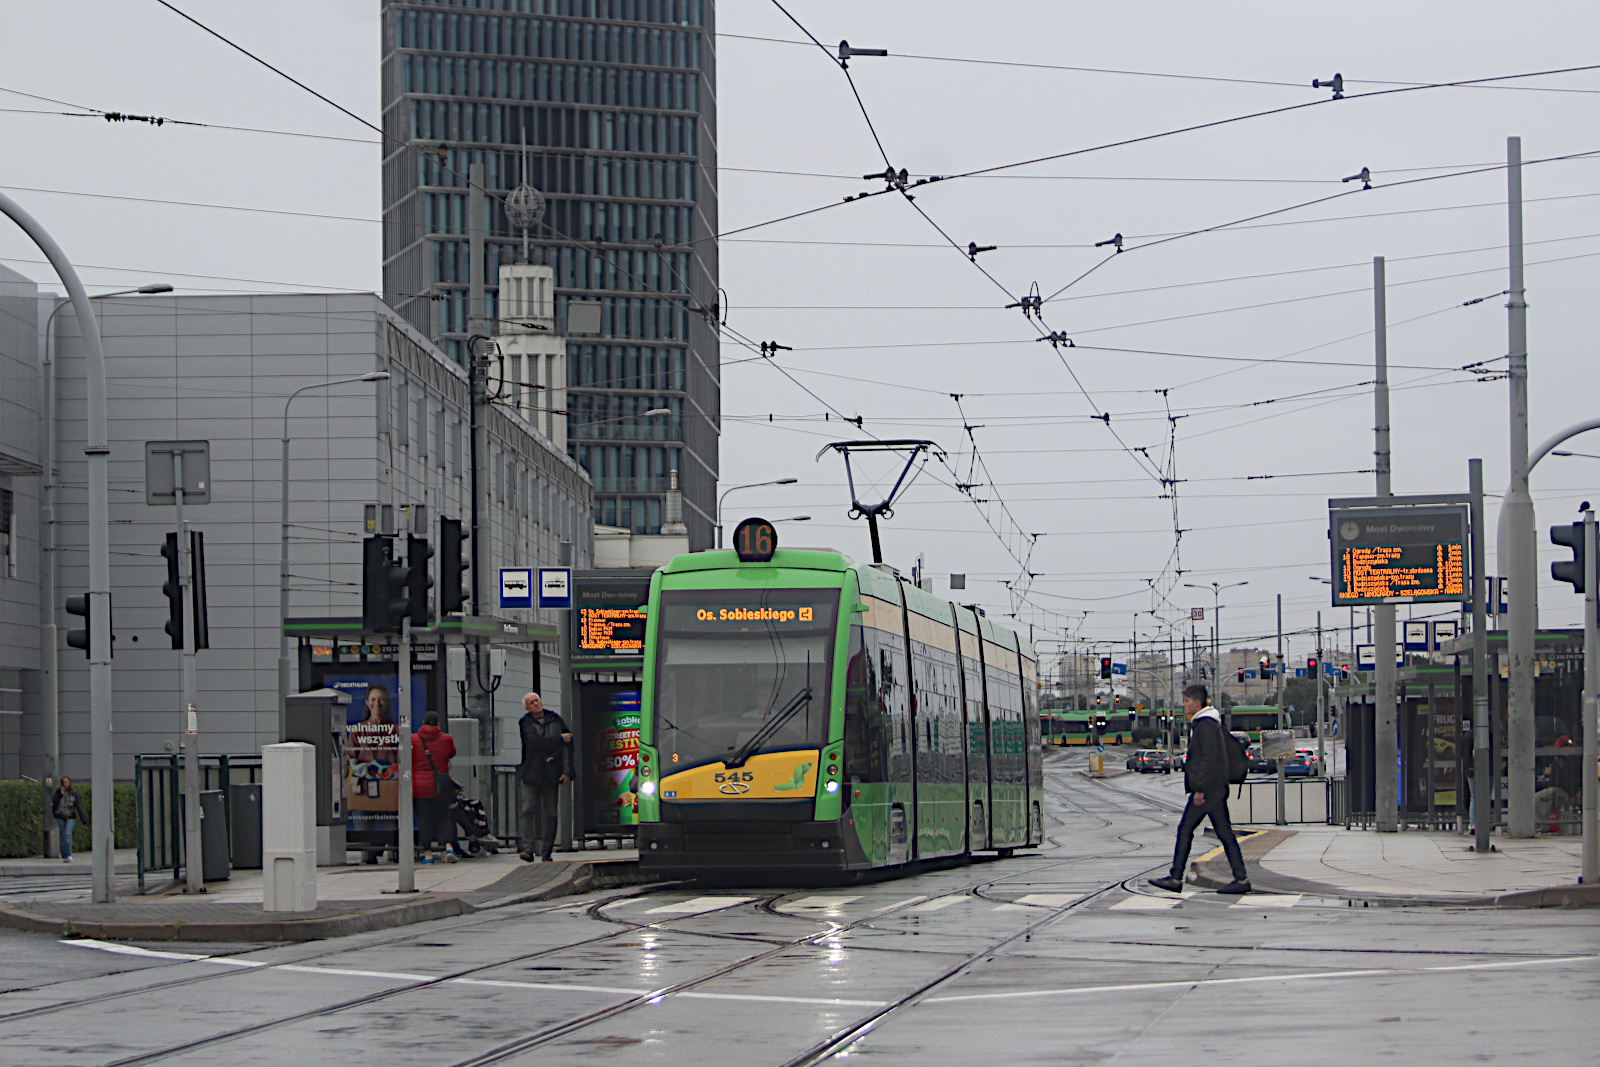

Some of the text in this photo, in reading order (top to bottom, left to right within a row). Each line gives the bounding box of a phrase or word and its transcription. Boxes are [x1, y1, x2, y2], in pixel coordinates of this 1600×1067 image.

[1366, 525, 1435, 533] Most Dworcowy
[740, 525, 772, 554] 16
[696, 608, 796, 622] Os. Sobieskiego
[357, 734, 400, 745] wszystk
[605, 731, 631, 740] STREET
[602, 738, 640, 750] FESTIV
[672, 753, 679, 762] 3
[714, 772, 754, 783] 545
